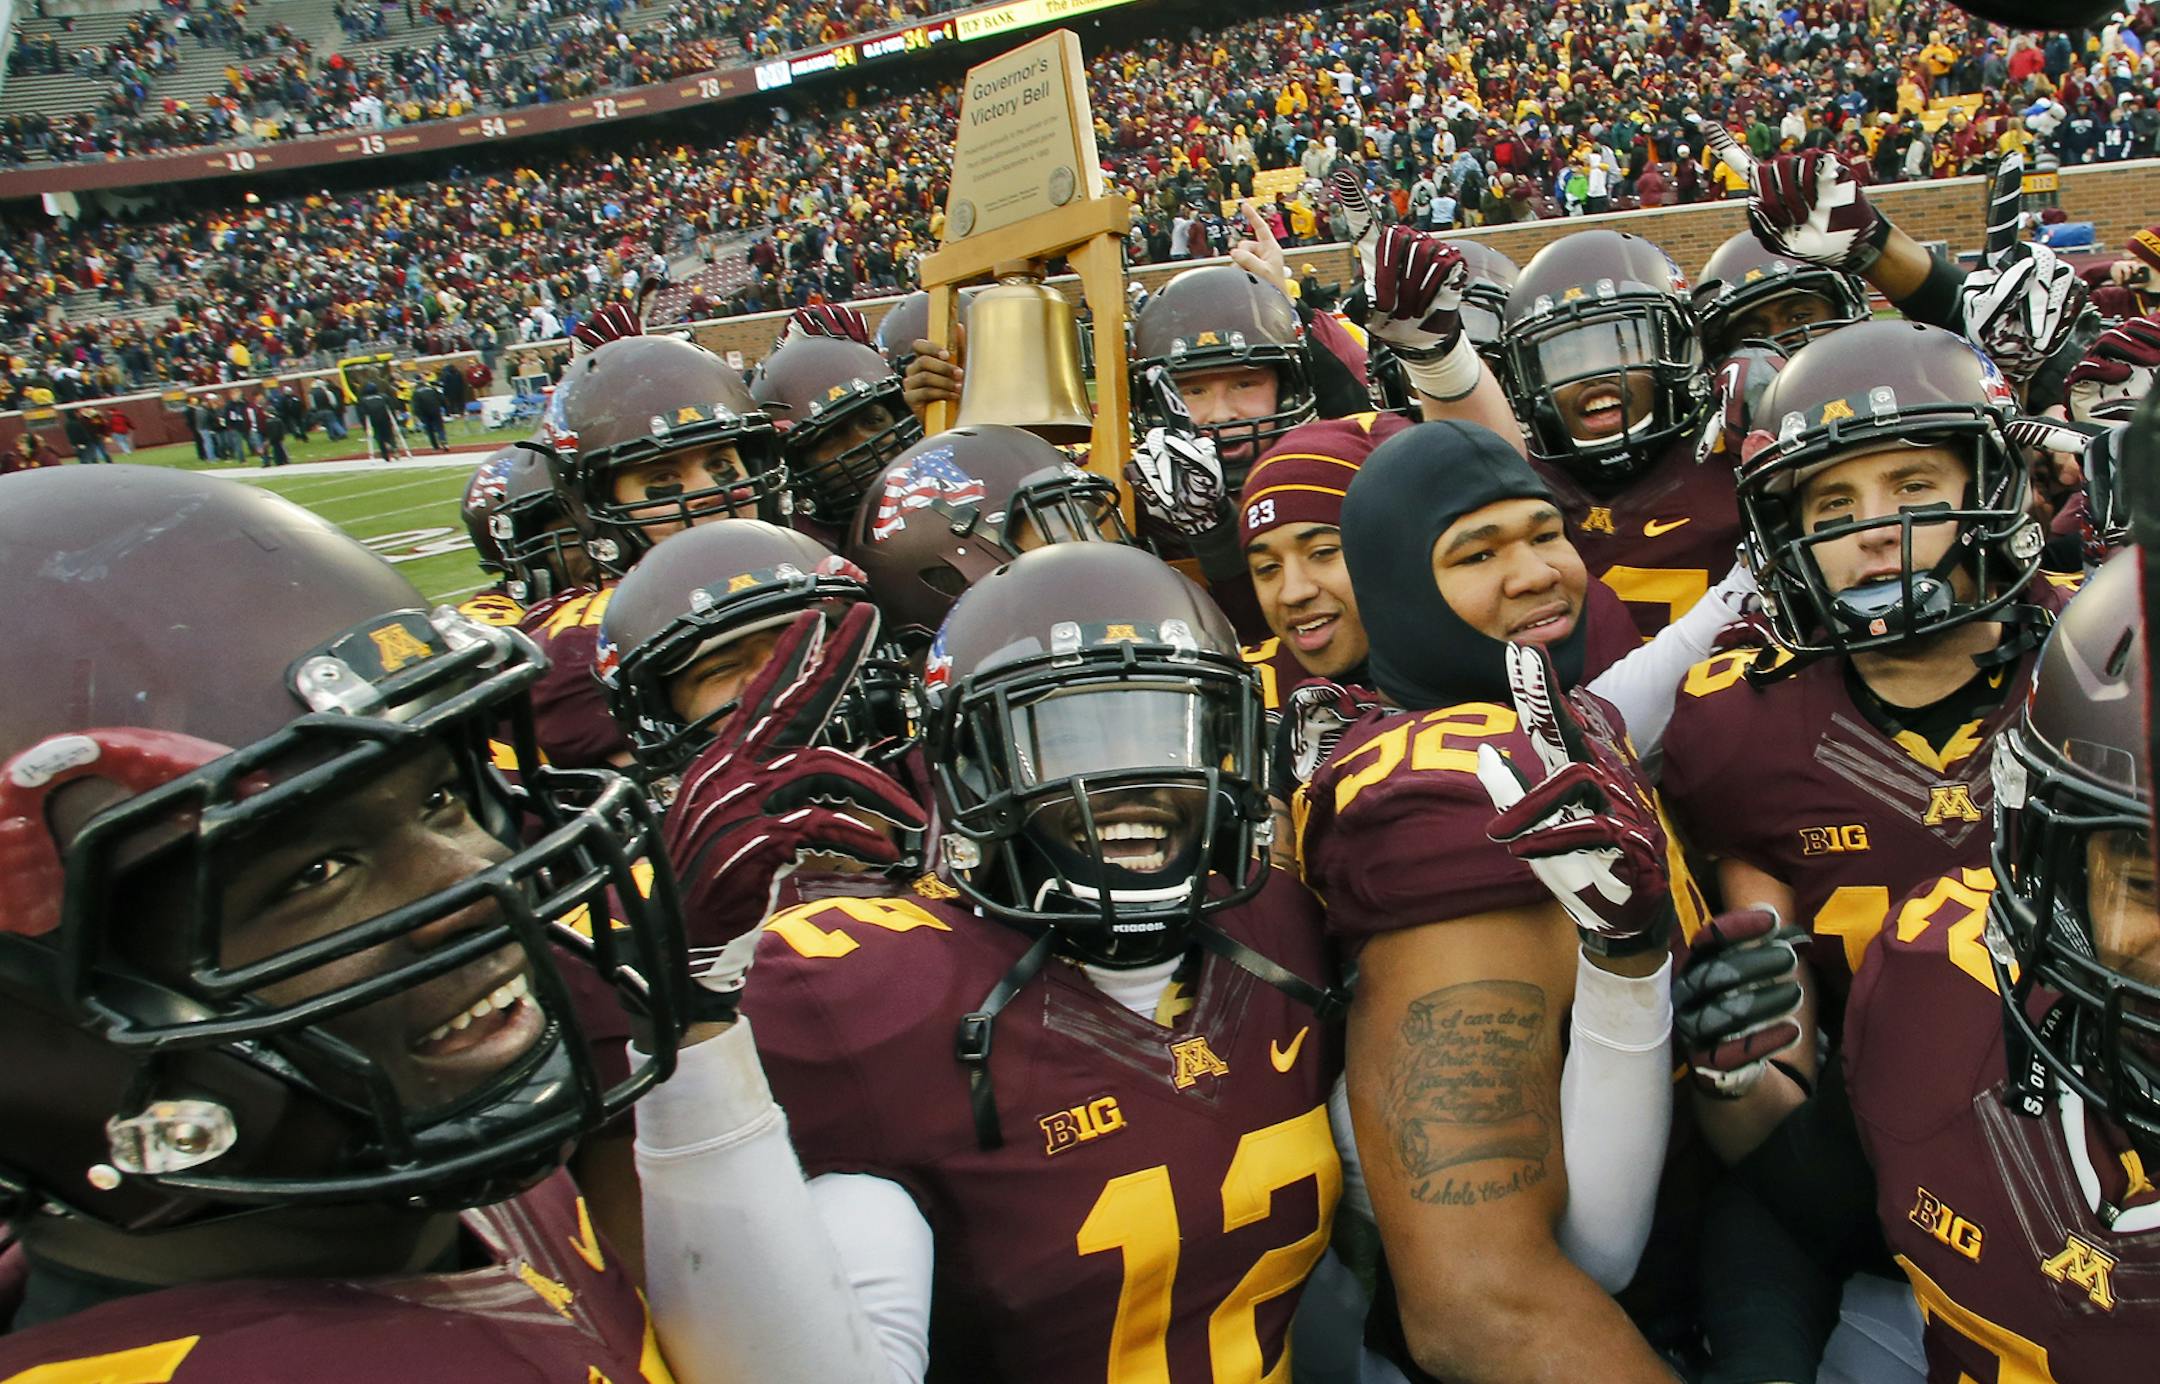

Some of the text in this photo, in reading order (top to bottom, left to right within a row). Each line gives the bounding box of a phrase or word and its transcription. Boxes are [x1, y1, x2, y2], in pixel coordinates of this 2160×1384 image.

[699, 77, 721, 99] 78
[972, 58, 1049, 101] Governor's
[592, 98, 618, 119] 72
[970, 80, 1050, 127] Victory Bell
[358, 135, 387, 155] 15
[479, 117, 507, 138] 54
[225, 151, 256, 172] 10
[1248, 498, 1276, 530] 23
[1923, 784, 1983, 827] M
[1169, 1035, 1230, 1090] M
[1076, 1102, 1343, 1384] 12
[2040, 1234, 2116, 1313] M
